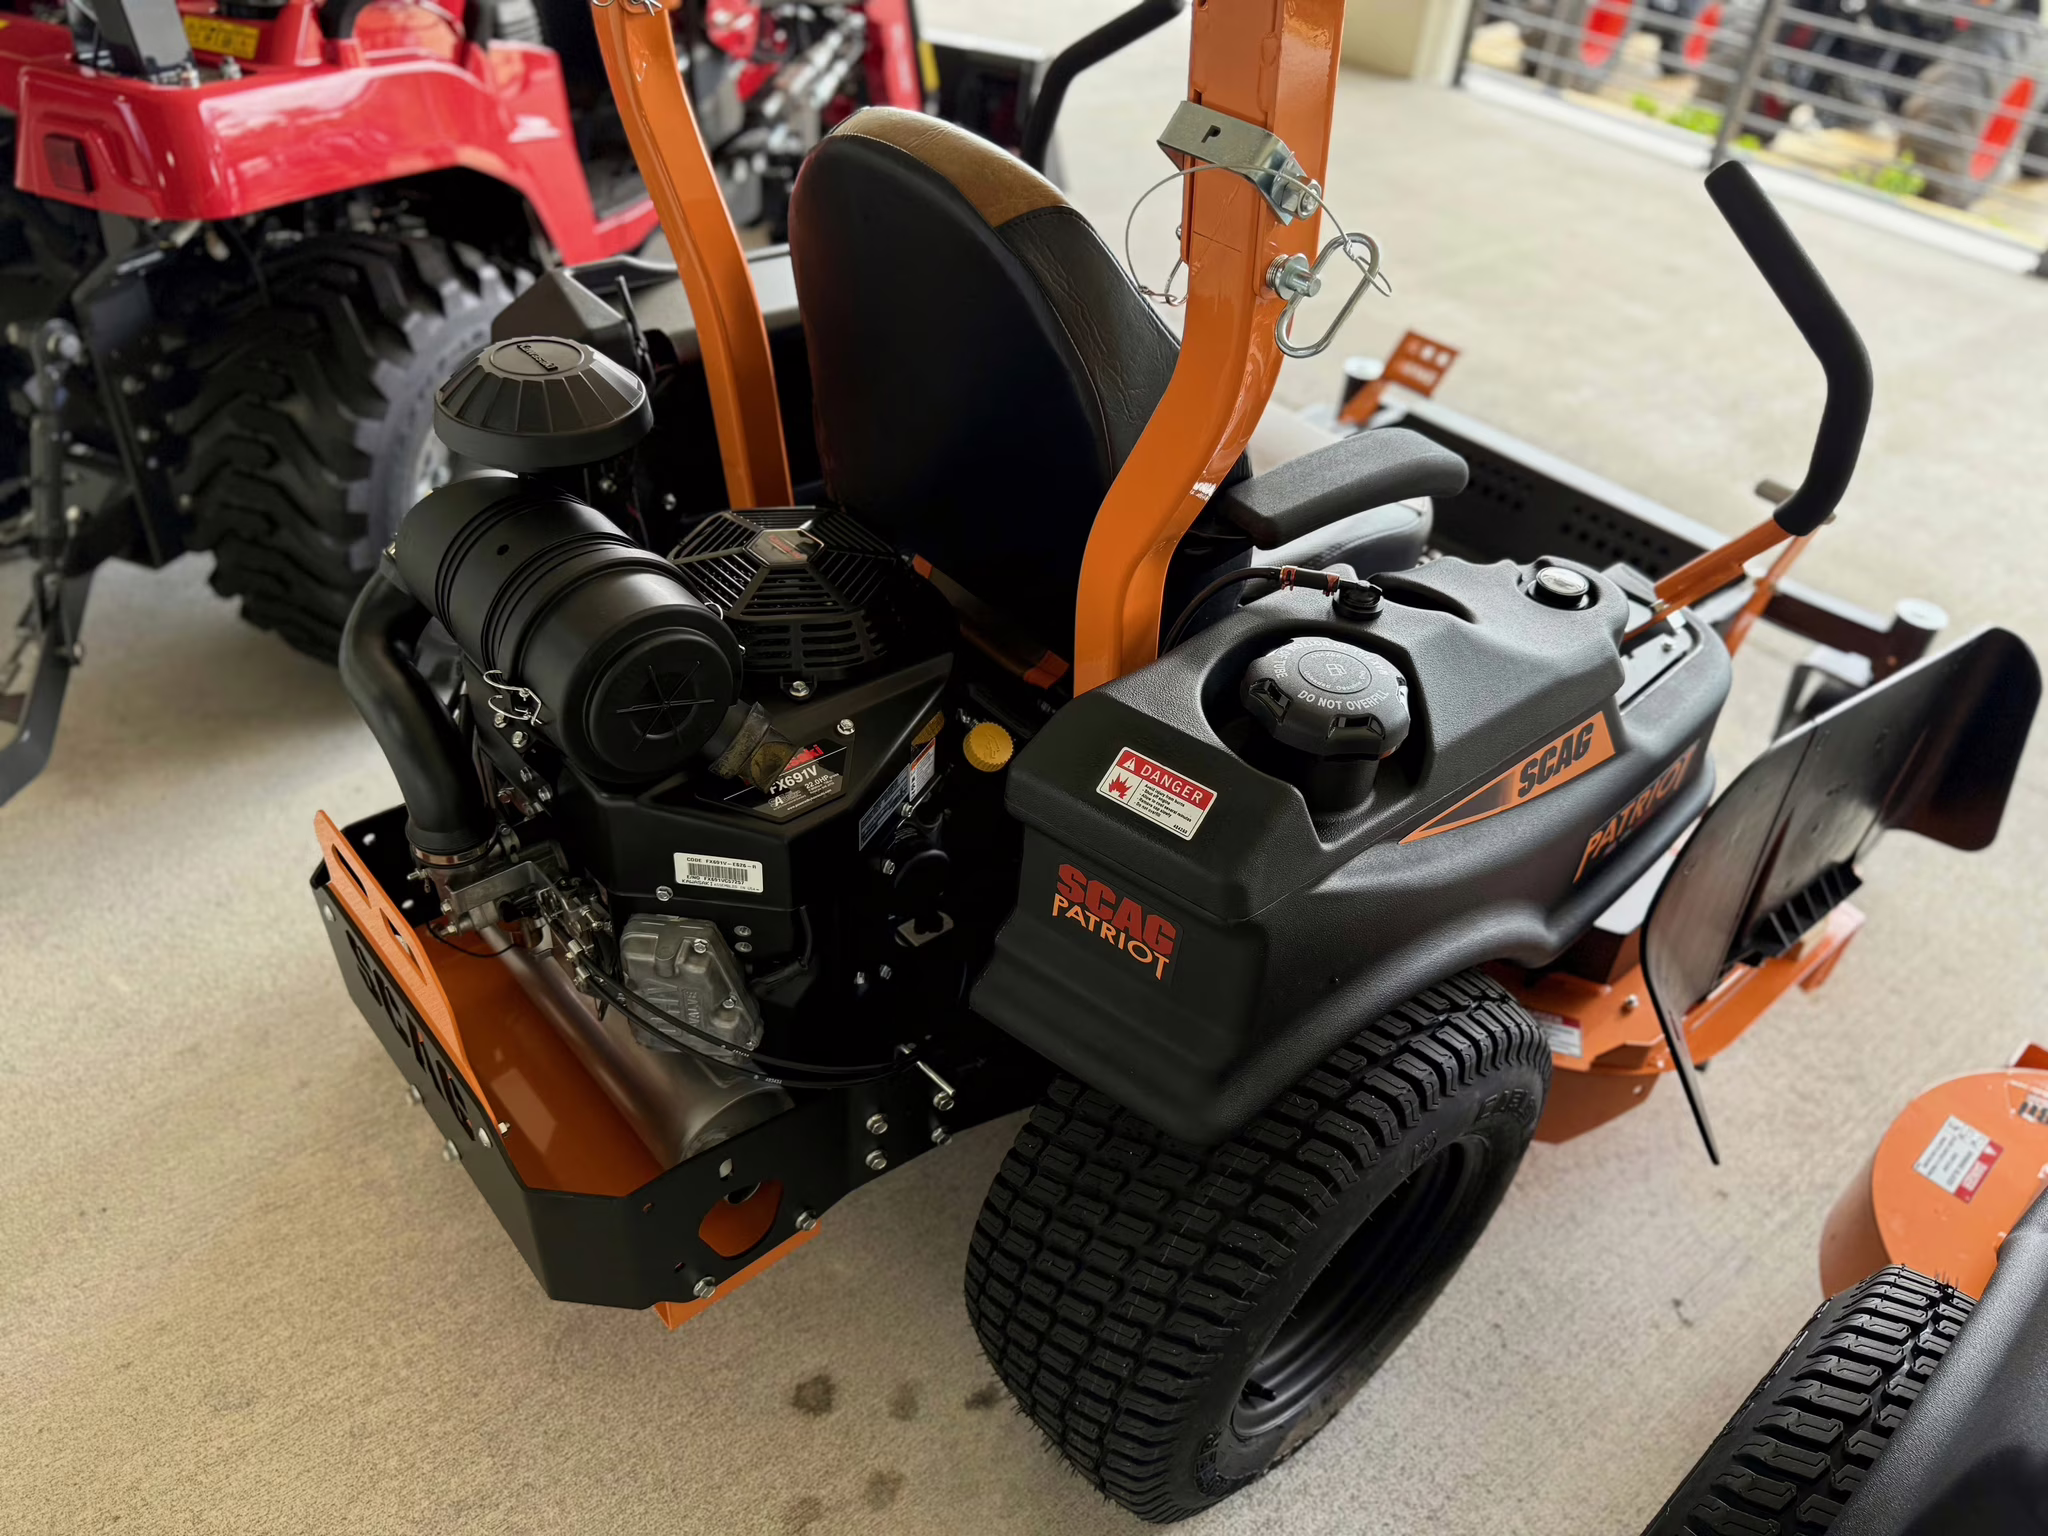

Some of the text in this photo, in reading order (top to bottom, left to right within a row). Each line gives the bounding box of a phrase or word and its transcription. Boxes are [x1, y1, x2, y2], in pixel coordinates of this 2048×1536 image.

[1273, 659, 1289, 680] TUBE
[1297, 689, 1390, 711] DO NOT OVERFILL
[1518, 722, 1594, 799] SCAG
[769, 764, 818, 795] FX691V
[804, 774, 830, 789] 22.0HP
[1140, 764, 1204, 804] DANGER
[1174, 799, 1185, 807] burns
[1573, 741, 1699, 884] PATRIOT
[681, 879, 713, 887] KAWASAKI
[1056, 864, 1177, 957] SCAG
[1052, 893, 1170, 981] PATRIOT
